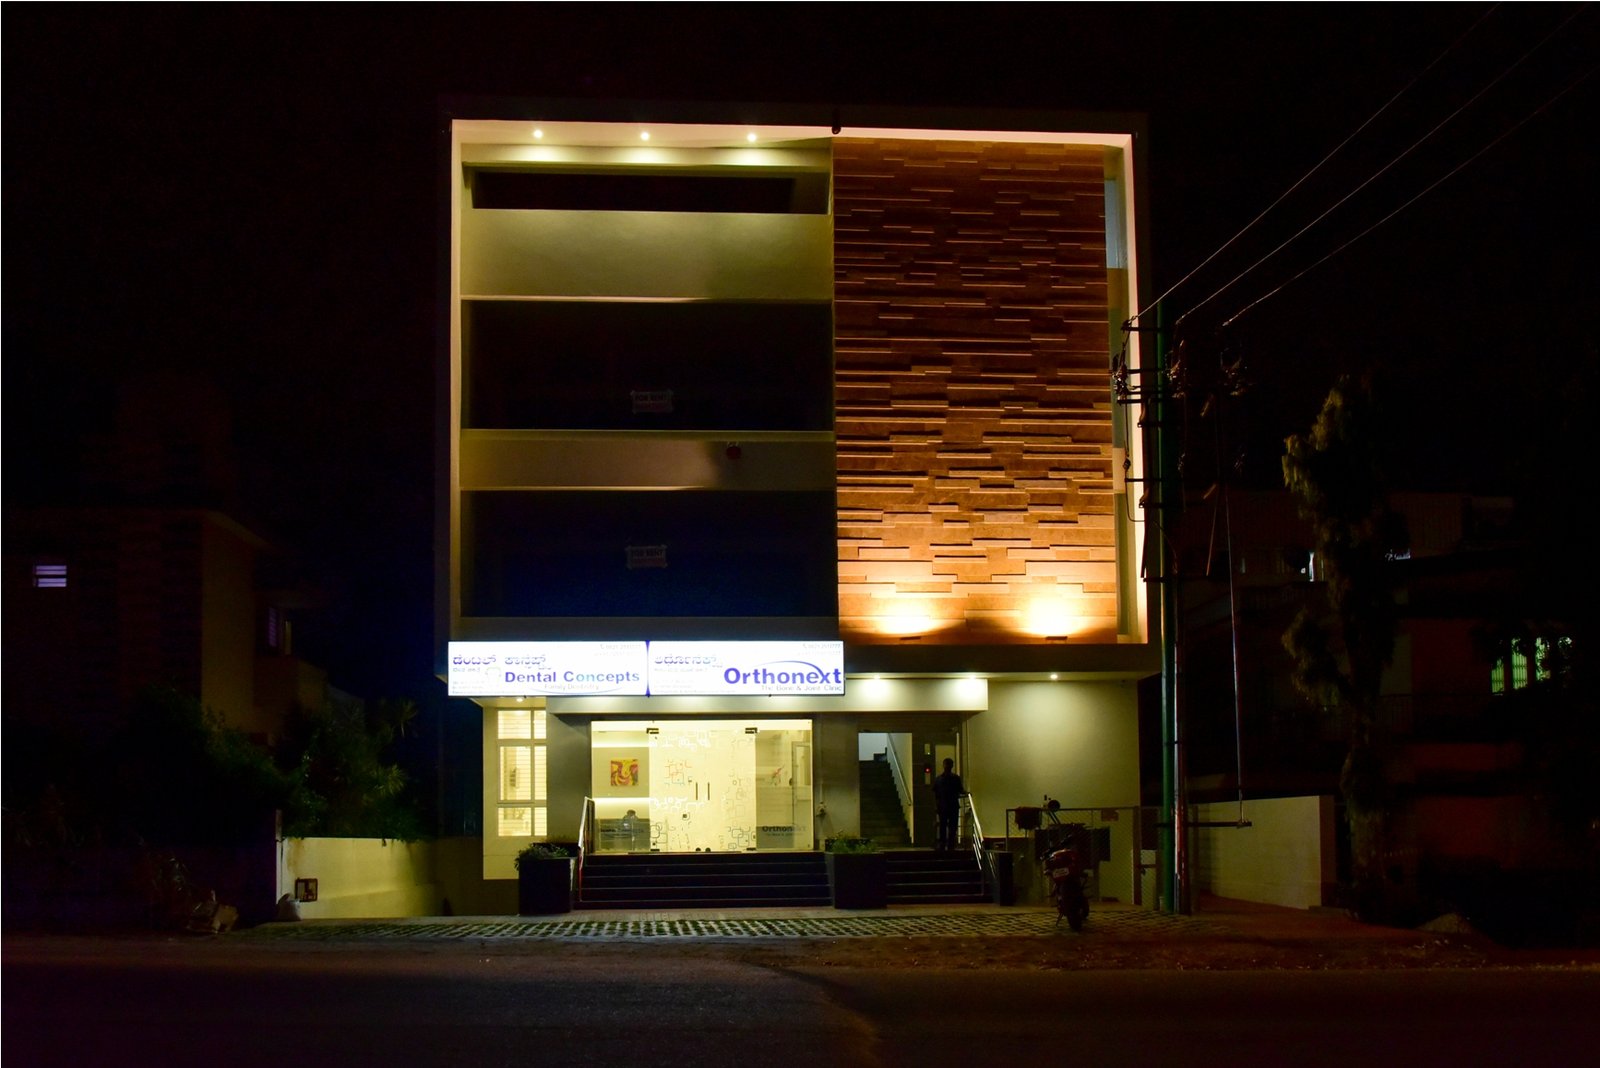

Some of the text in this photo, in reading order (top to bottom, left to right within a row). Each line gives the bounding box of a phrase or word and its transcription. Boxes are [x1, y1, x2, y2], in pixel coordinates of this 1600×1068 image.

[504, 671, 640, 684] Dental Concepts
[723, 667, 842, 685] Orthonext
